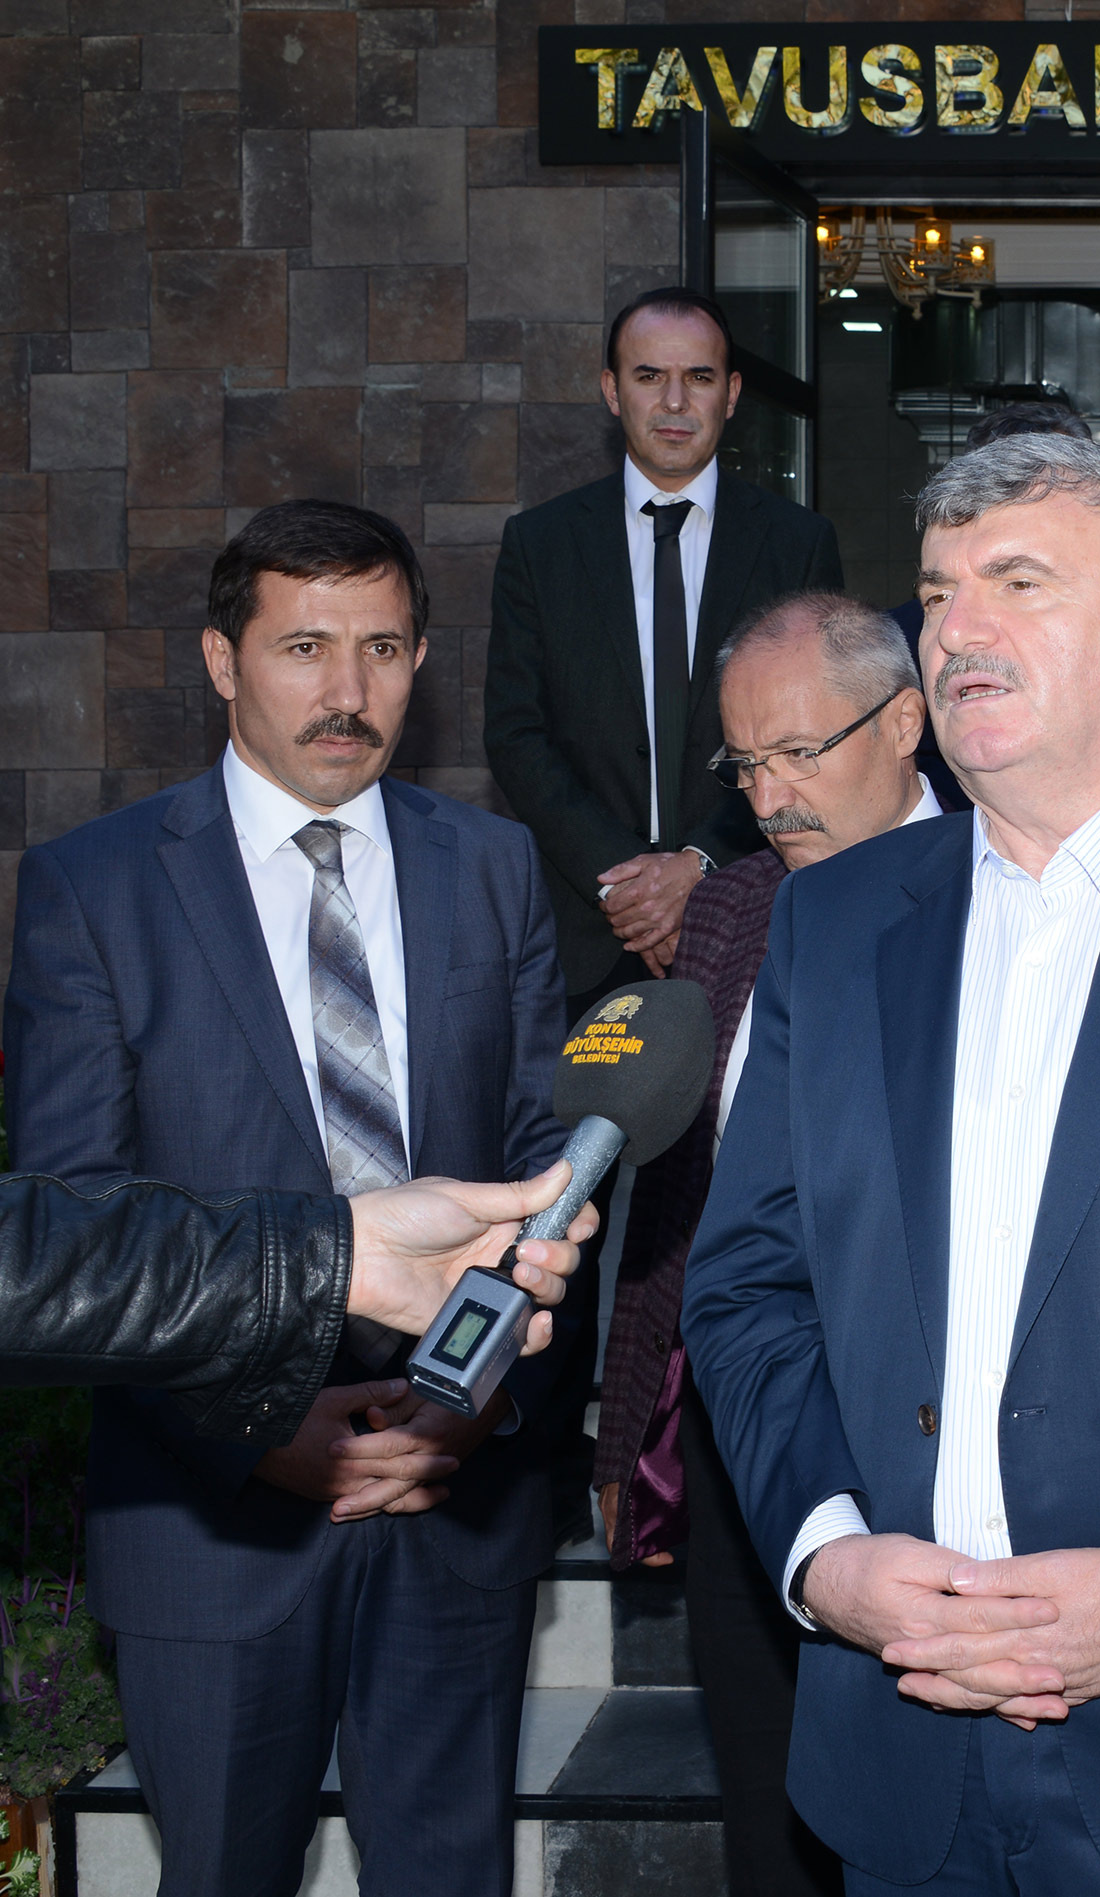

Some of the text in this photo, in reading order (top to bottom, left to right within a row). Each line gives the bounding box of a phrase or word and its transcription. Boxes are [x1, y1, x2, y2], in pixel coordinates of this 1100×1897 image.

[584, 1023, 627, 1036] KONYA
[562, 1034, 644, 1056] BÜYÜKŞEHİR
[571, 1052, 621, 1064] BELEDİYESİ
